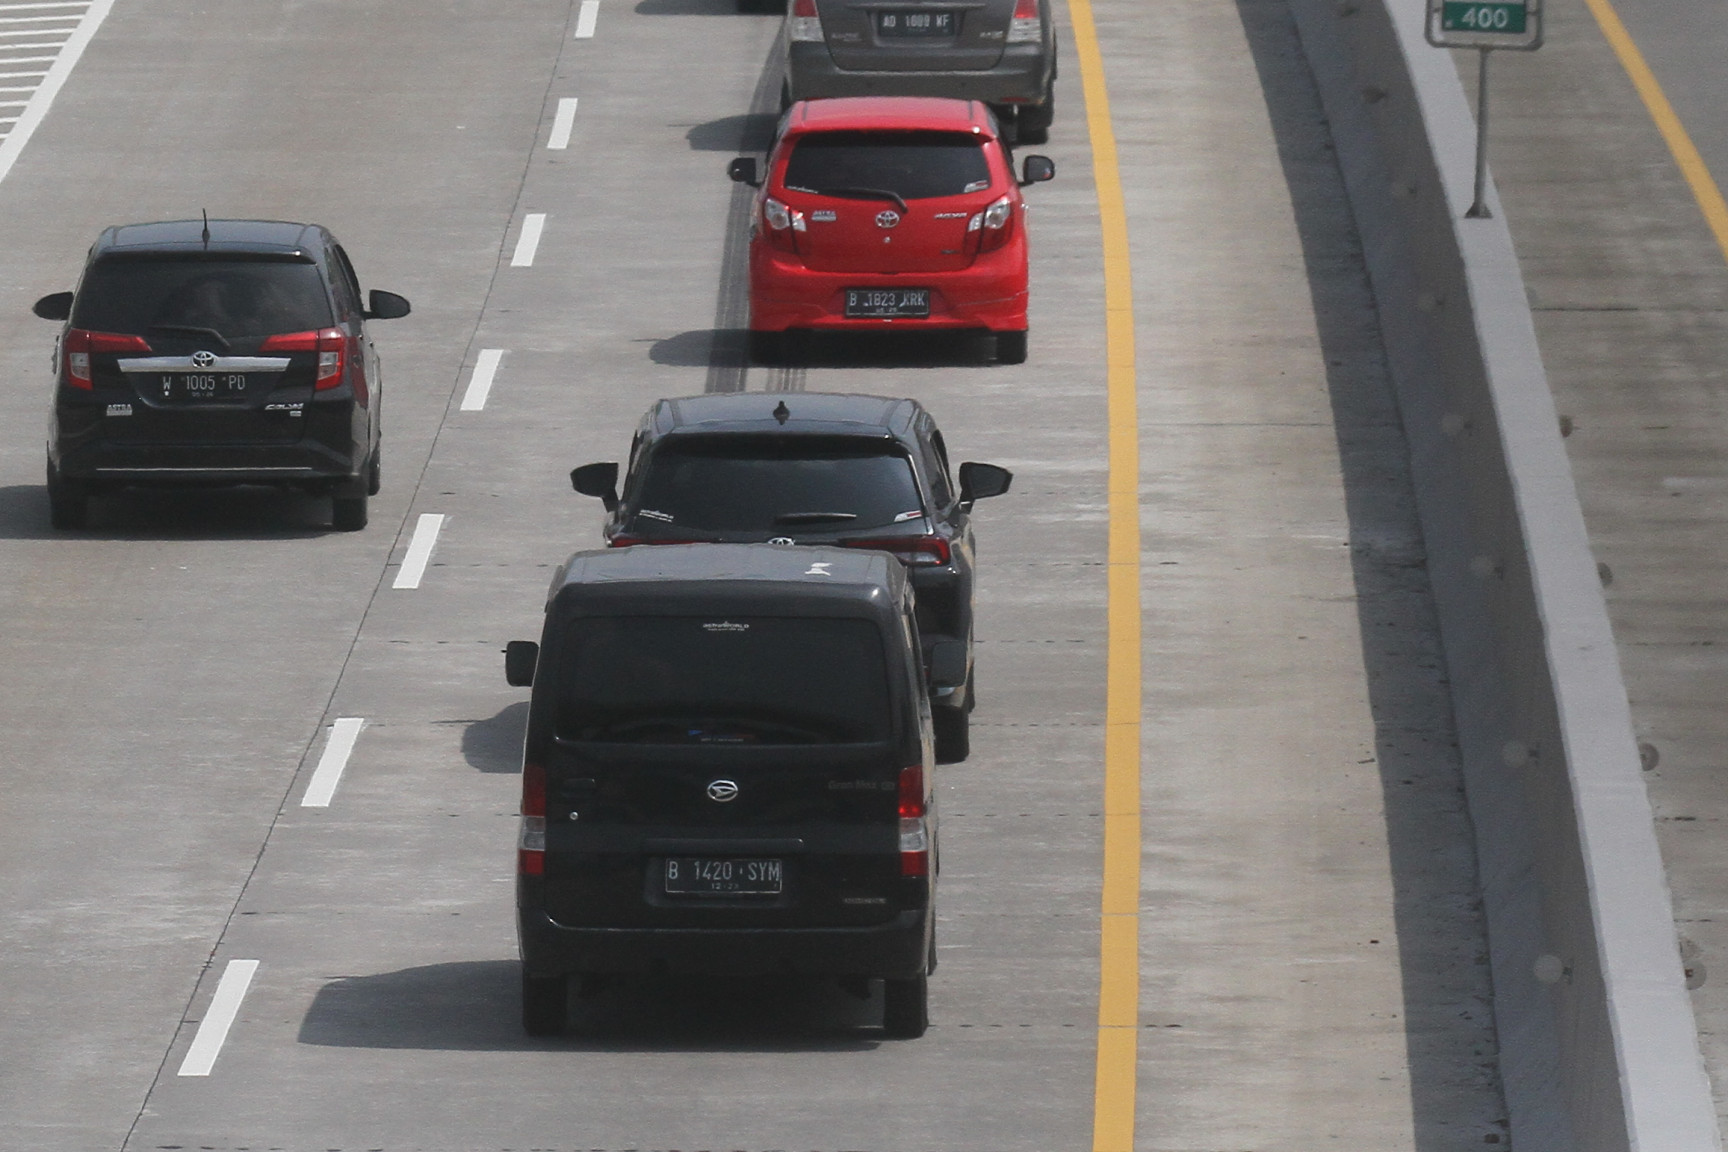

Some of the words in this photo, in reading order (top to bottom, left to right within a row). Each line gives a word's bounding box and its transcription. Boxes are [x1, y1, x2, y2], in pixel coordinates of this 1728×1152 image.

[1461, 6, 1509, 29] 400
[849, 292, 858, 307] B
[162, 376, 172, 391] W
[186, 375, 216, 391] 1005
[228, 375, 246, 391] PD
[668, 861, 679, 880] B
[694, 861, 732, 881] 1420
[747, 861, 781, 882] SYM
